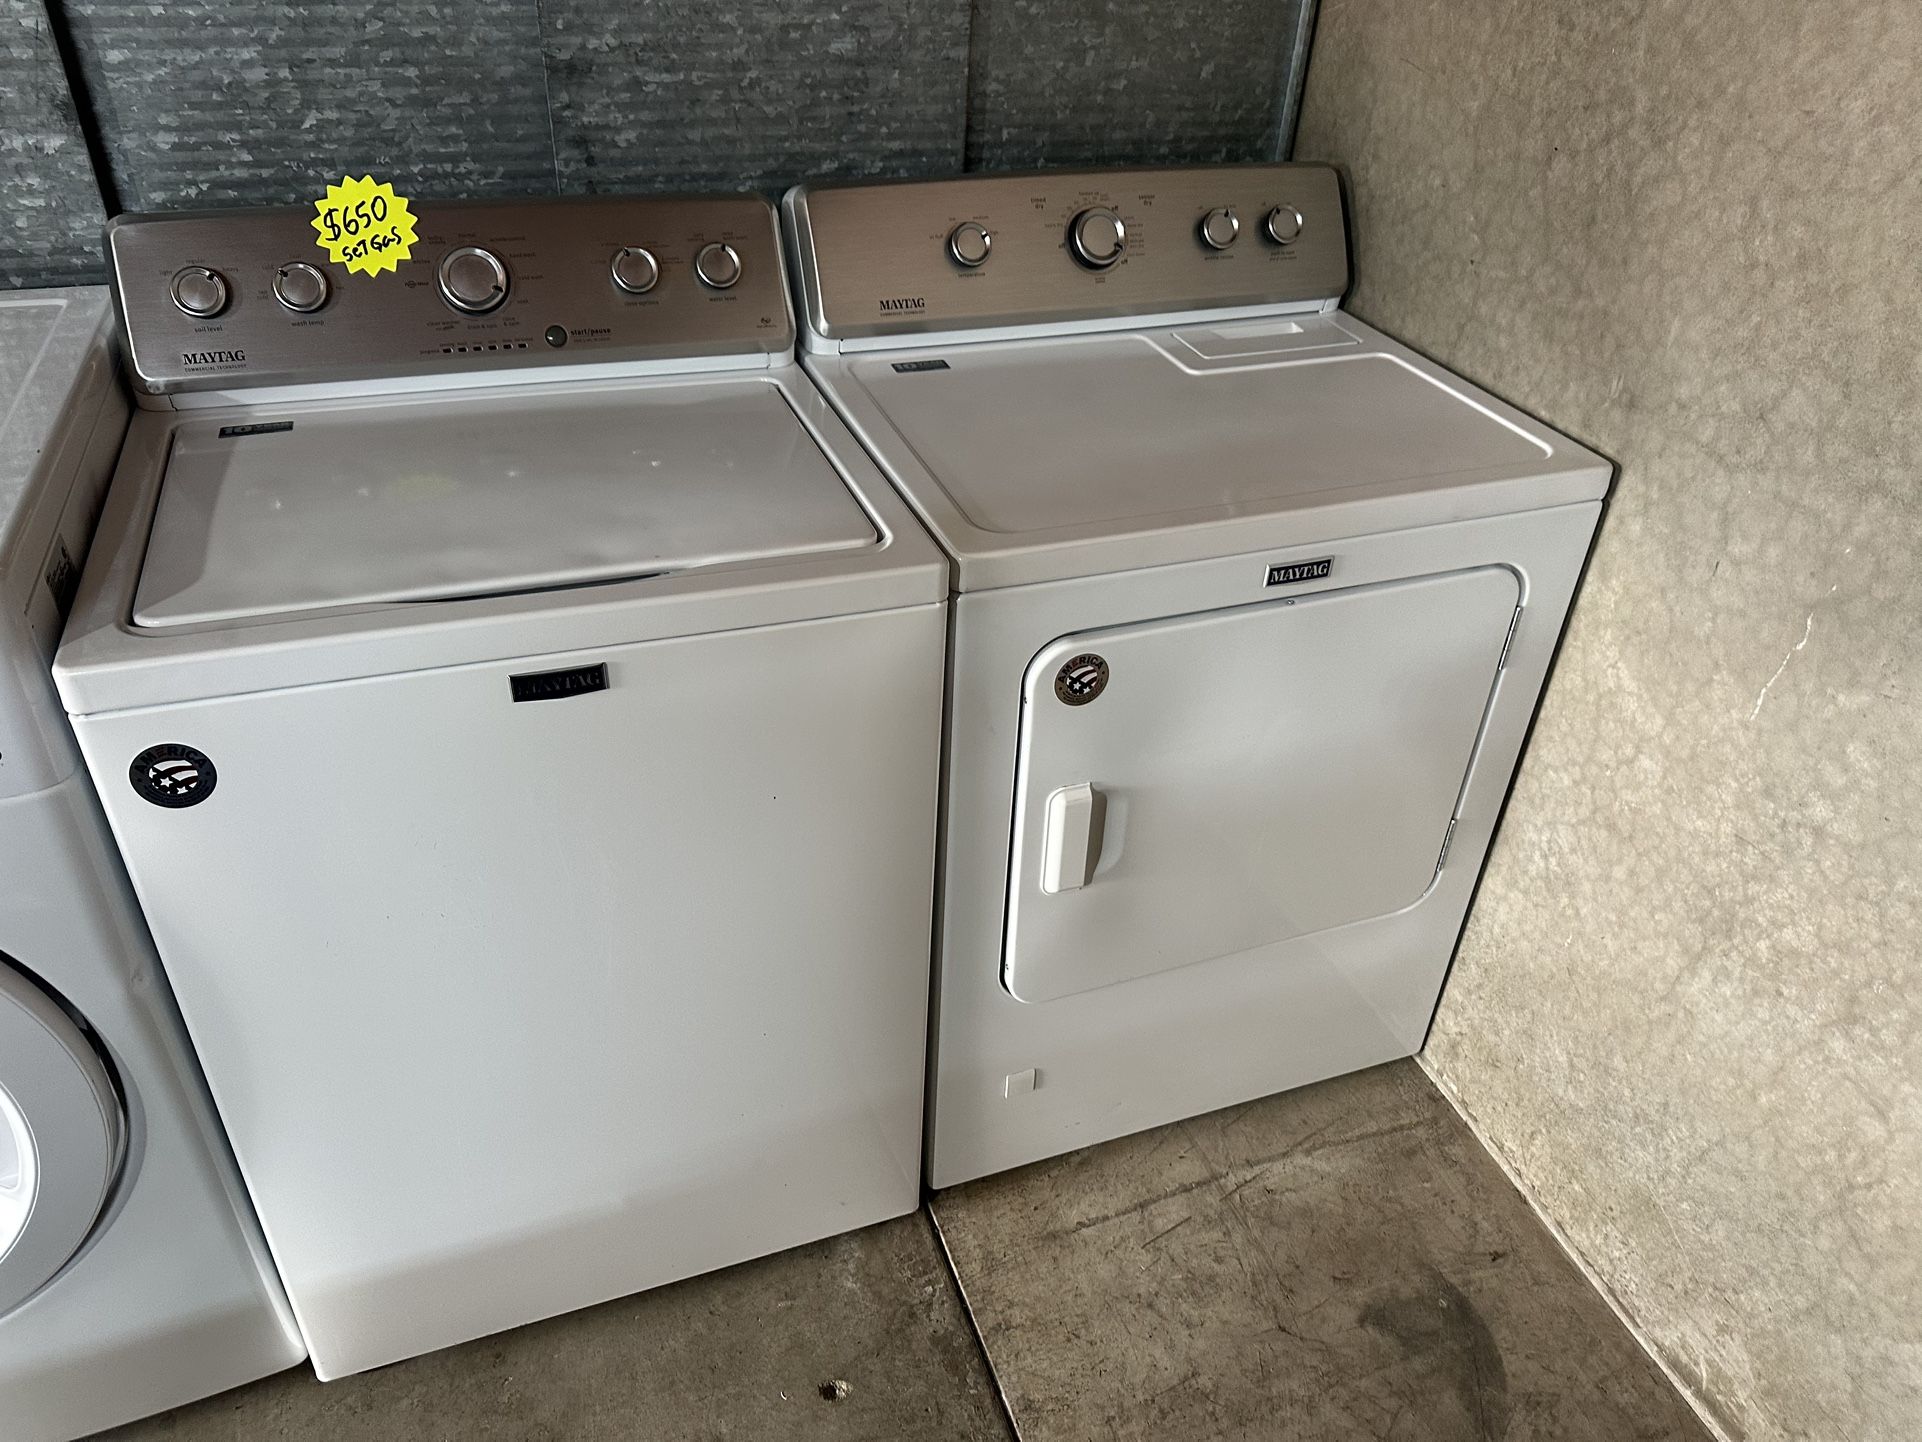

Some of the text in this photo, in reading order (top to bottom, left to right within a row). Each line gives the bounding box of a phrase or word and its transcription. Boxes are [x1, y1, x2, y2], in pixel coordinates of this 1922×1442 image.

[323, 195, 388, 242] $650
[879, 297, 925, 311] MAYTAG
[182, 350, 246, 366] MAYTAG
[1270, 562, 1329, 583] MAYTAG
[1058, 655, 1104, 684] AMERICA
